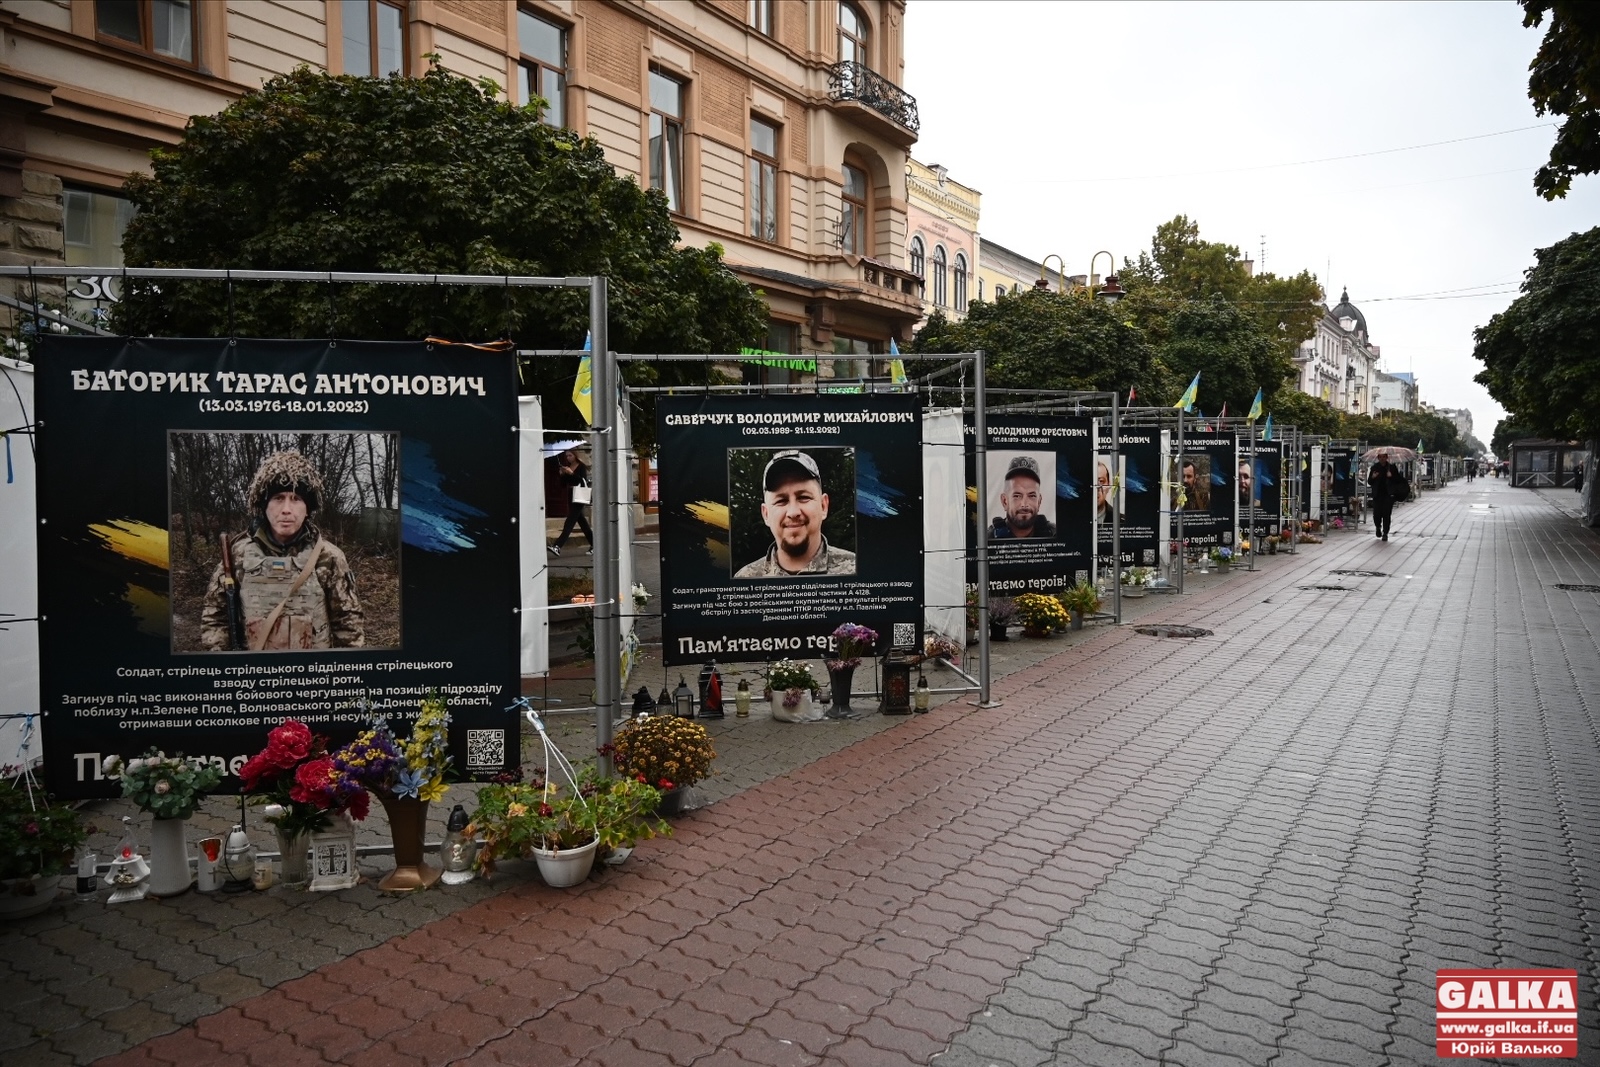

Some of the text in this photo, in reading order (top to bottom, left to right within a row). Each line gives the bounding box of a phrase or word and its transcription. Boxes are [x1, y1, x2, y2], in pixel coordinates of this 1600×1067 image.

[71, 369, 486, 396] БАТОРИК ТАРАС АНТОНОВИЧ
[199, 398, 369, 414] (13.03.1976-18.01.2023)
[665, 409, 914, 425] САВЕРЧУК ВОЛОДИМИР МИХАЙЛОВИЧ
[987, 426, 1040, 437] ВОЛОДИМИР
[1041, 427, 1088, 437] ОРЕСТОВИЧ
[696, 585, 749, 594] гранатометник
[755, 584, 800, 592] стрілецького
[844, 581, 888, 589] стрілецького
[1028, 574, 1067, 590] героїв!
[702, 601, 714, 609] під
[749, 599, 794, 608] російськими
[795, 598, 838, 606] окупантами,
[844, 596, 880, 604] результаті
[881, 596, 914, 604] ворожого
[722, 592, 762, 601] стрілецької
[763, 592, 780, 600] роти
[781, 590, 818, 599] військової
[701, 608, 732, 617] обстрілу
[740, 606, 792, 615] застосуванням
[813, 604, 842, 613] поблизу
[856, 603, 887, 611] Павлівка
[762, 612, 828, 622] Донецької області.
[678, 635, 802, 655] Пам'ятаємо
[116, 660, 453, 678] Солдат, стрілець стрілецького відділення стрілецького
[213, 676, 364, 689] взводу стрілецької роти.
[62, 694, 114, 705] Загинув
[117, 692, 137, 704] під
[140, 694, 162, 703] час
[165, 692, 232, 702] виконання
[235, 690, 293, 701] бойового
[296, 689, 366, 700] чергування
[368, 688, 383, 697] на
[441, 683, 503, 695] підрозділу
[74, 706, 128, 718] поблизу
[202, 703, 237, 715] Поле,
[239, 701, 331, 713] Волноваського
[446, 695, 493, 707] області,
[119, 719, 192, 730] отримавши
[195, 717, 260, 727] осколкове
[396, 711, 403, 720] з
